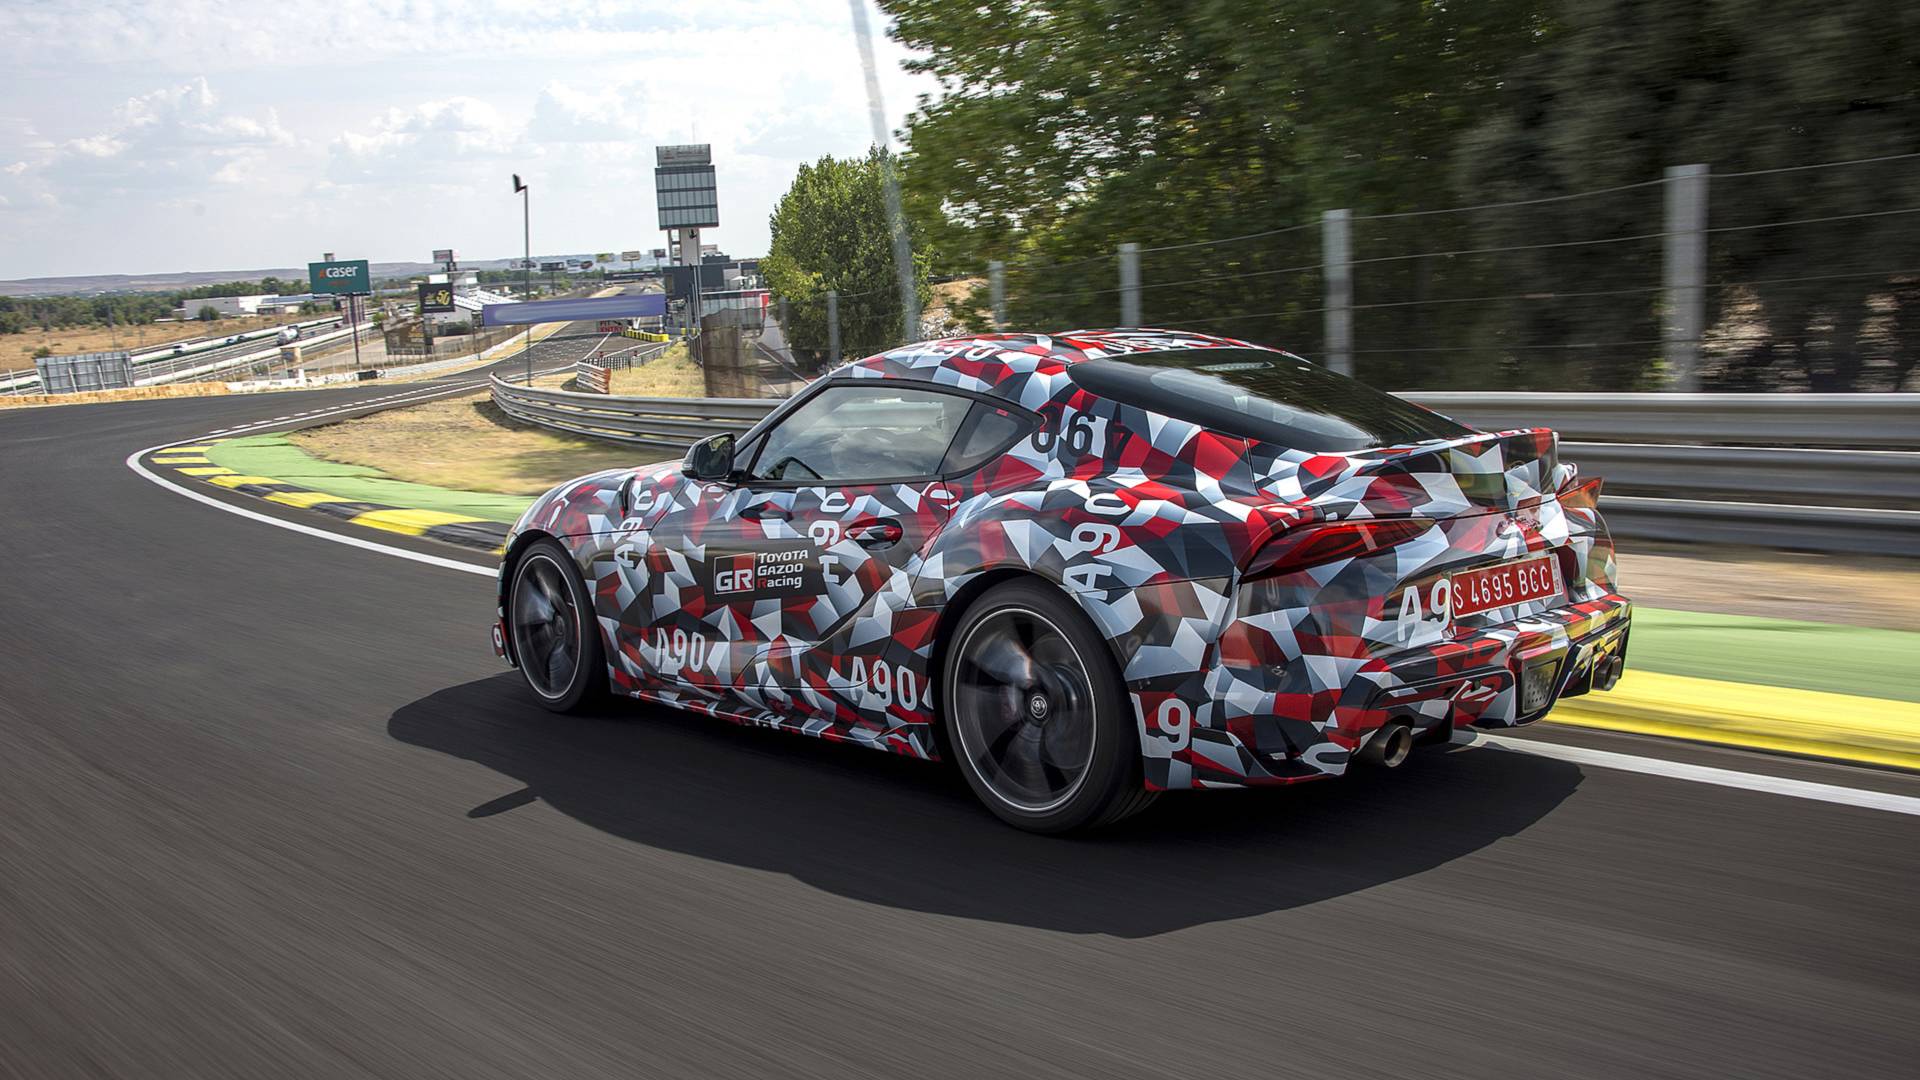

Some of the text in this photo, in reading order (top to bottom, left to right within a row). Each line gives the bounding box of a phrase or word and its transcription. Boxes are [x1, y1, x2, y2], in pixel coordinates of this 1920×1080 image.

[326, 266, 358, 278] caser
[757, 549, 808, 564] TOYOTA
[1062, 492, 1132, 601] A90
[716, 569, 753, 591] GR
[757, 563, 804, 576] GAZOO
[757, 576, 802, 589] Racing
[1453, 583, 1464, 610] S
[1471, 572, 1513, 606] 4695
[655, 627, 705, 674] A90
[851, 656, 917, 711] A90
